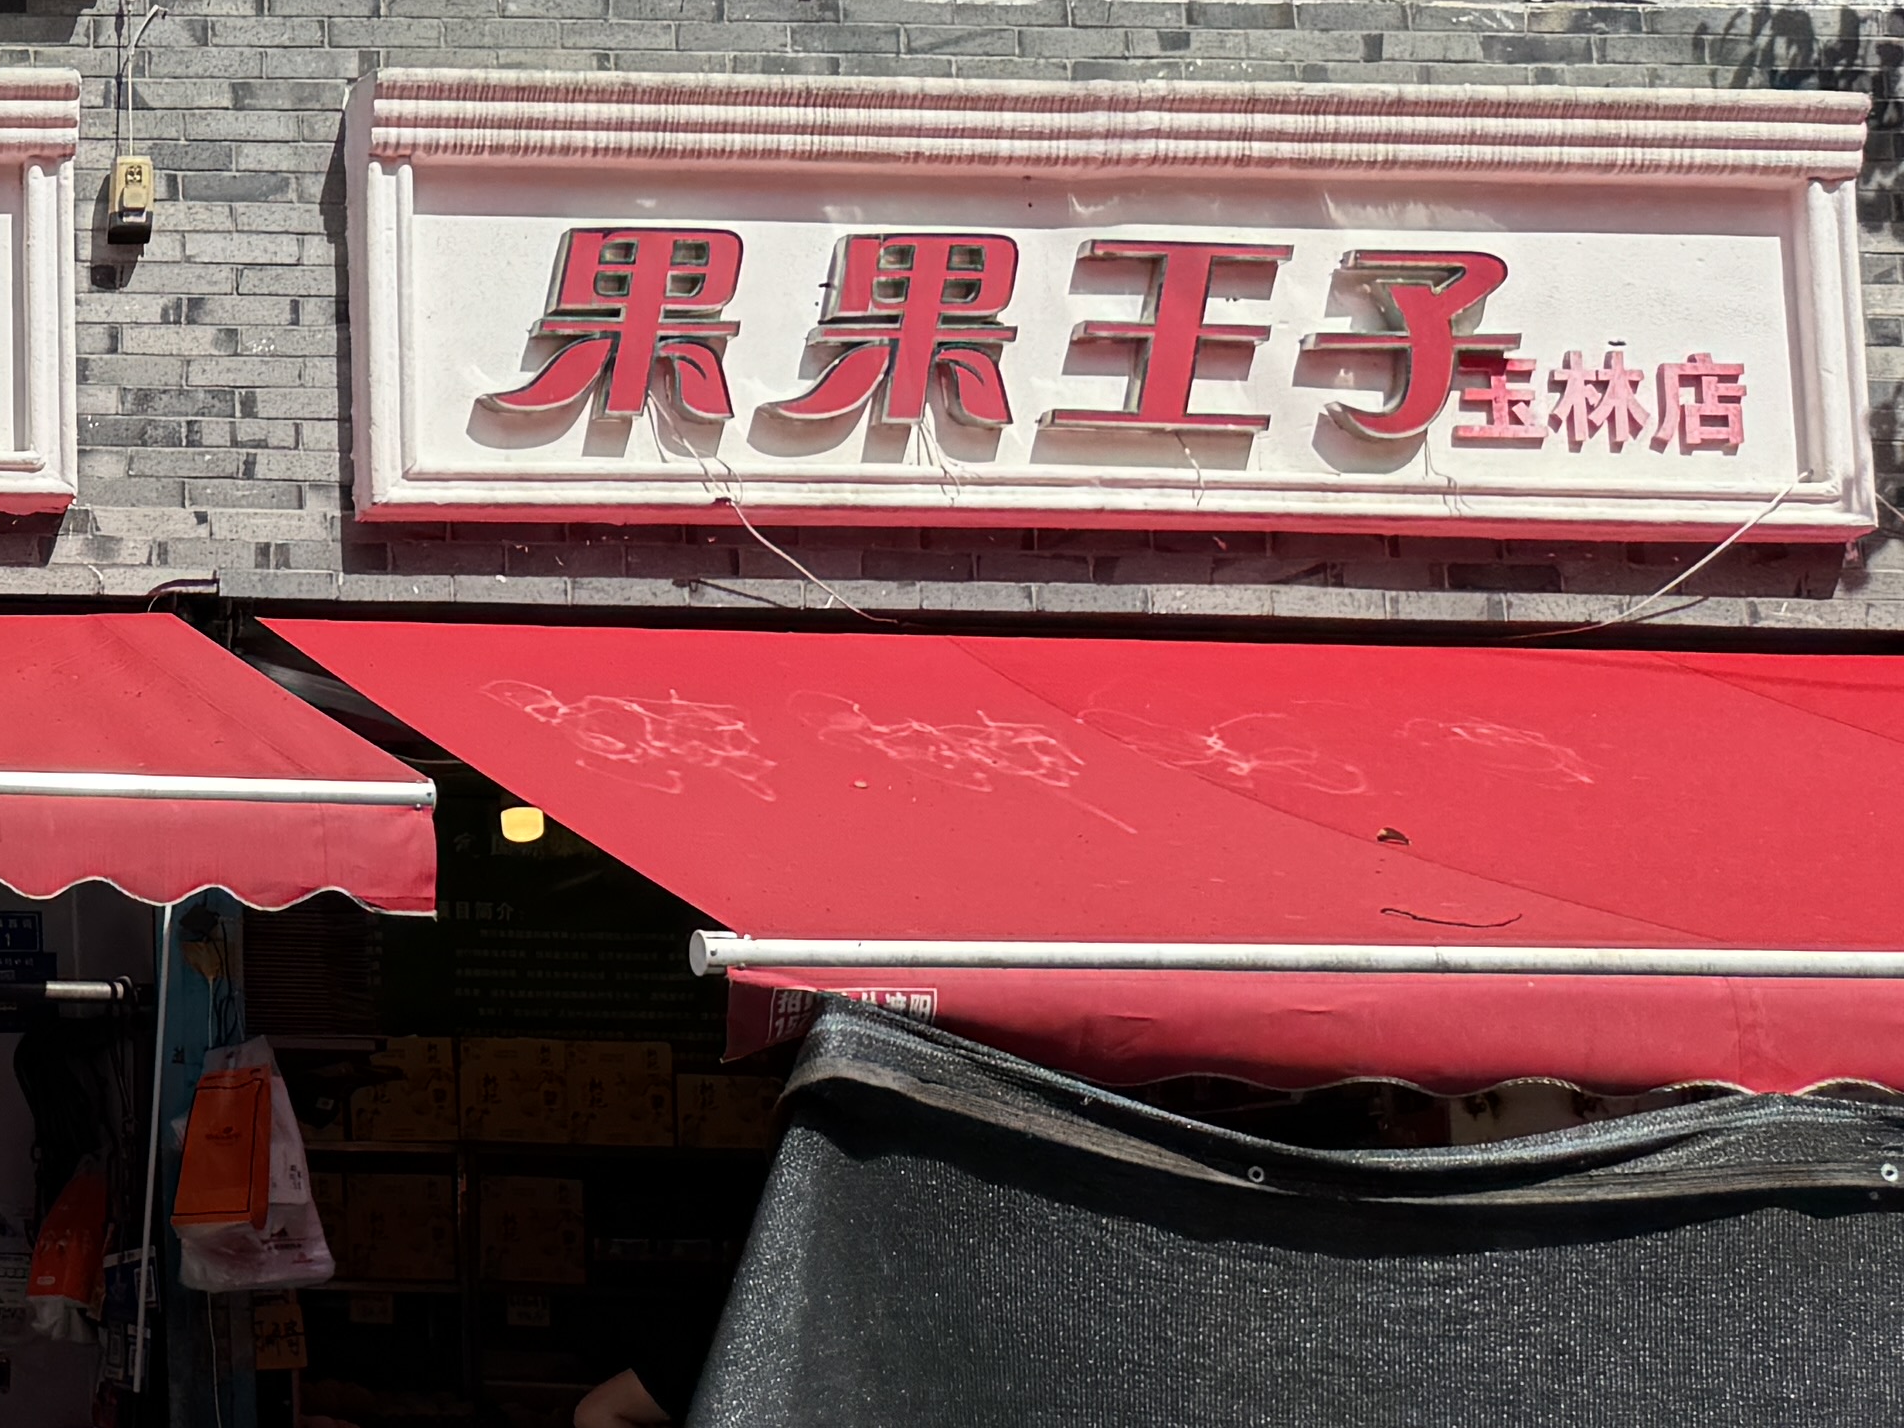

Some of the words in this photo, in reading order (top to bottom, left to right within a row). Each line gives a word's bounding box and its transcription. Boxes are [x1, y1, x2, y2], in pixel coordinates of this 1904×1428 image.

[479, 224, 1522, 440] 果果王子
[1451, 350, 1747, 448] 玉林店
